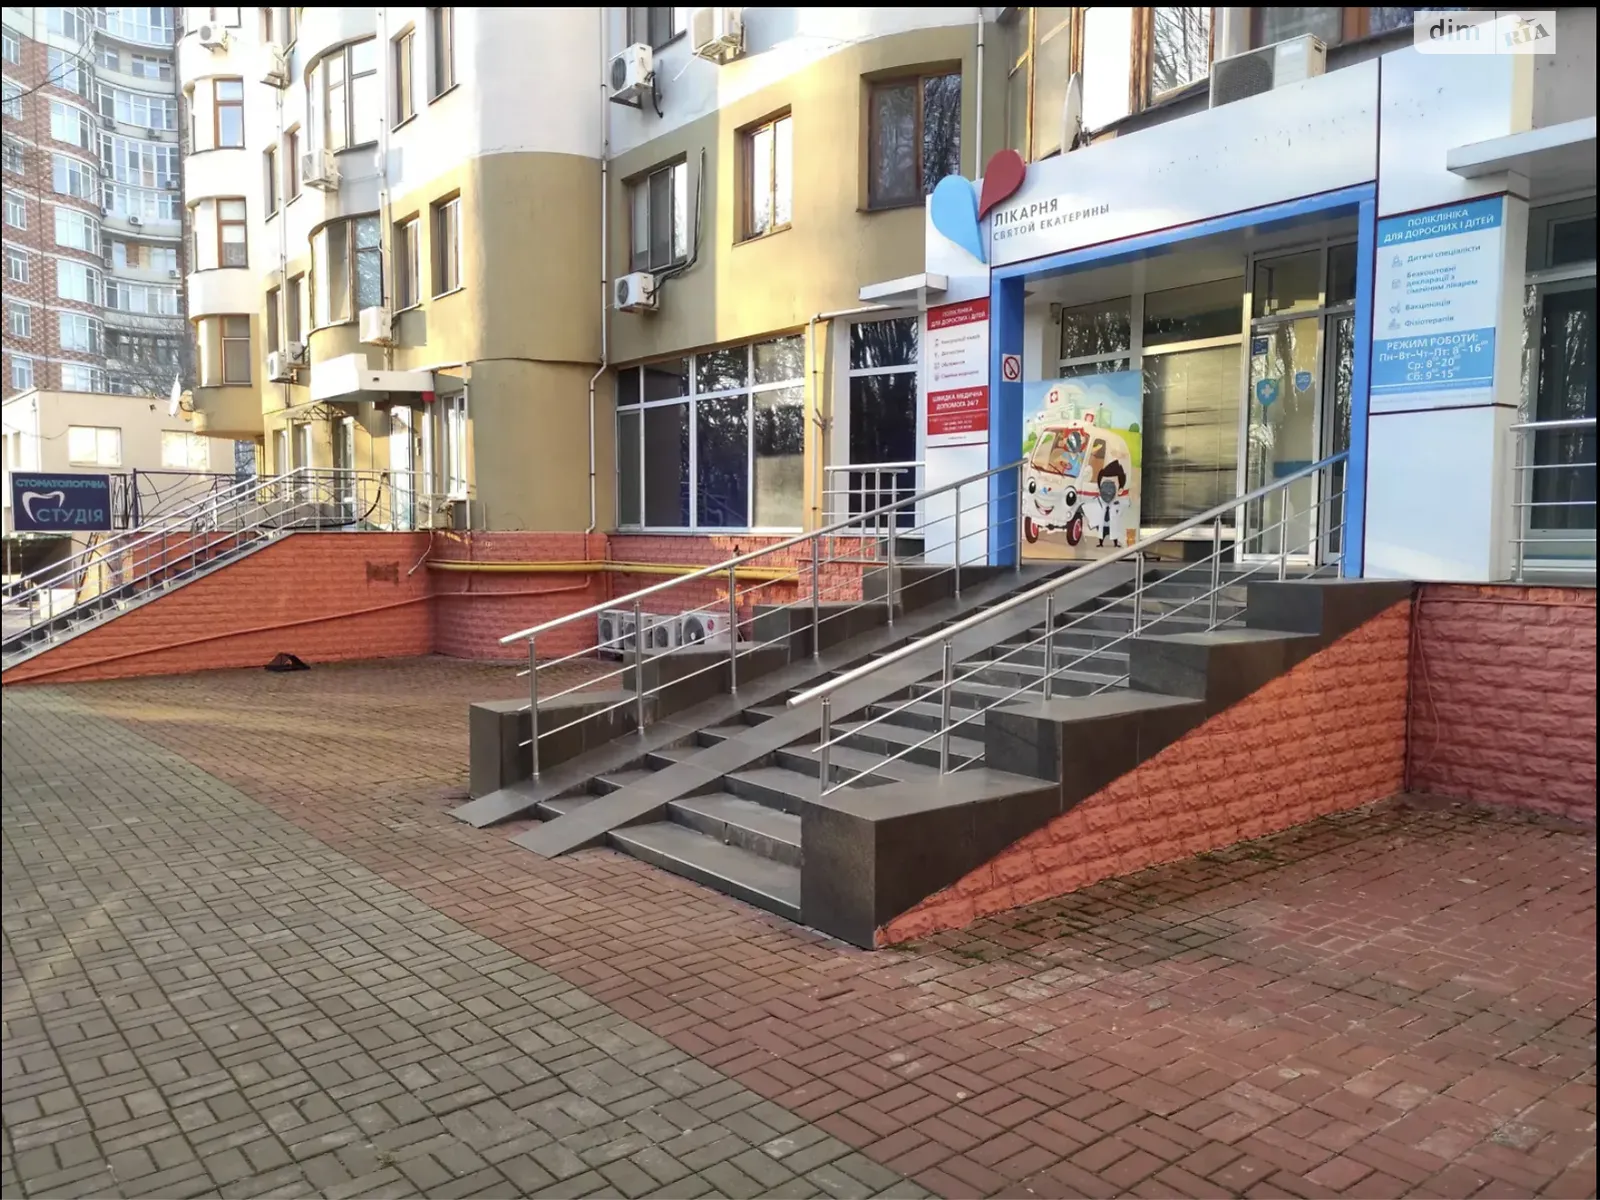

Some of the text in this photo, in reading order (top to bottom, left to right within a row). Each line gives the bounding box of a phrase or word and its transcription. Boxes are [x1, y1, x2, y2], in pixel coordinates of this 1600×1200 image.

[994, 198, 1058, 227] ЛІКАРНЯ
[1407, 209, 1469, 227] ПОЛІКЛІНІКА
[993, 203, 1110, 241] СВЯТОЙ ЕКАТЕРИНЫ
[1384, 232, 1403, 244] ДЛЯ
[1404, 221, 1458, 240] ДОРОСЛИХ
[1464, 213, 1494, 229] ДІТЕЙ
[1386, 333, 1479, 351] РЕЖИМ РОБОТИ:
[1407, 361, 1424, 371] Ср:
[36, 508, 104, 525] СТУДІЯ
